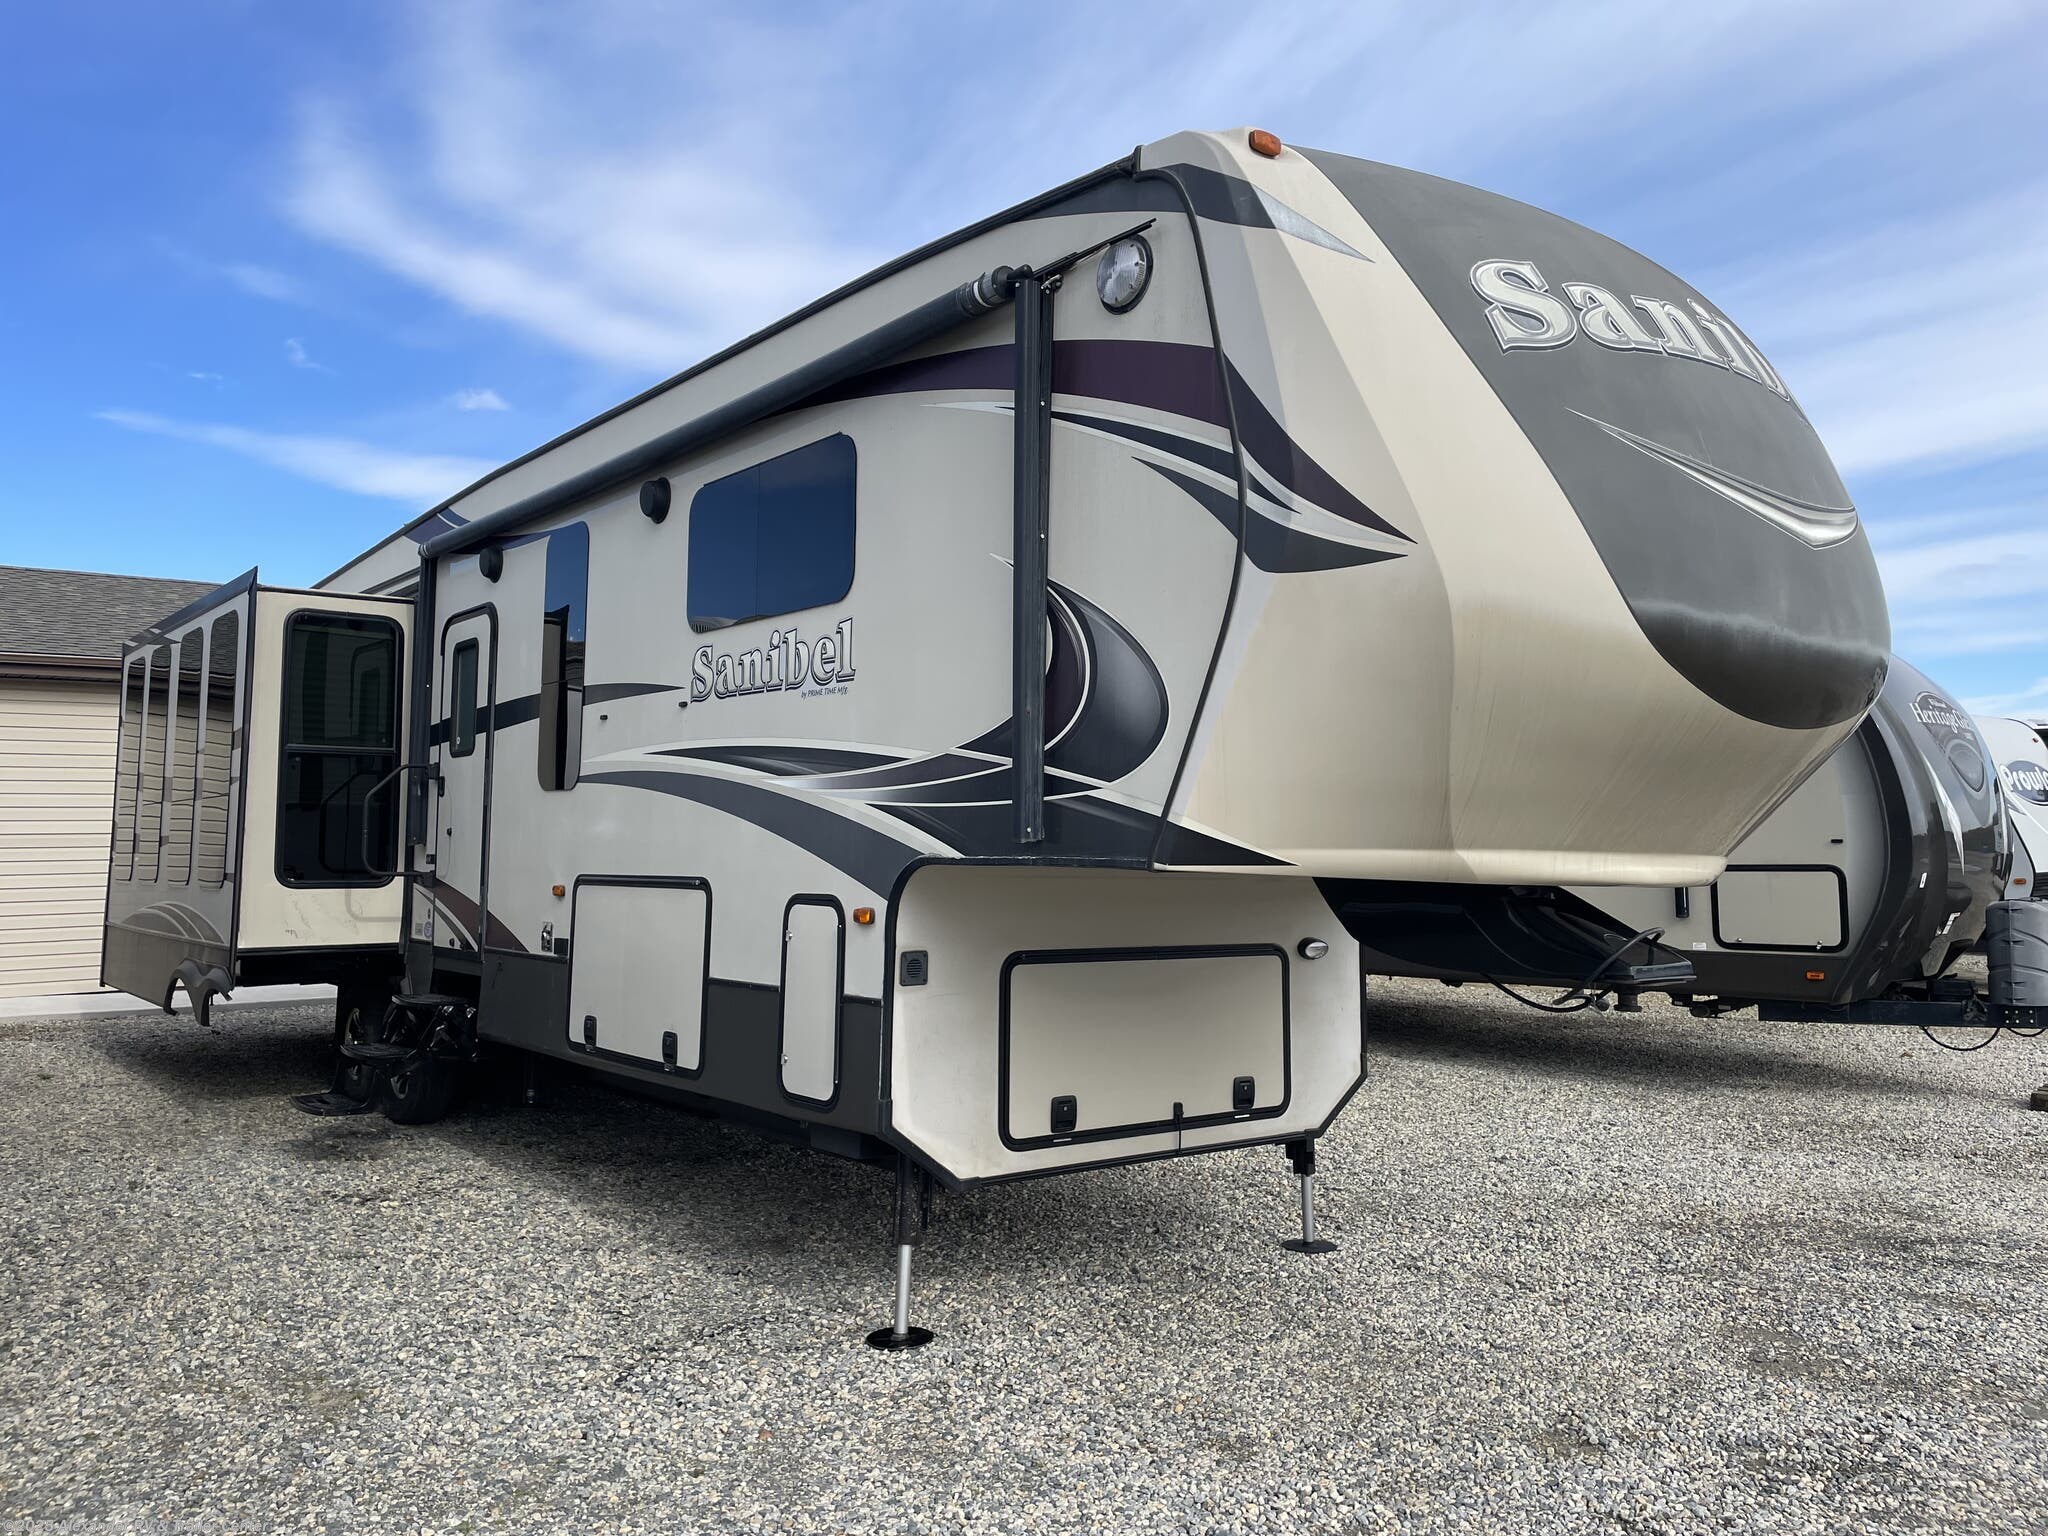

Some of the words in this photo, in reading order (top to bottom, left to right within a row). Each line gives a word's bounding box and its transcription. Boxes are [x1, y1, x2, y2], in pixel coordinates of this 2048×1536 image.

[690, 617, 856, 703] Sanibel
[808, 688, 823, 697] PRIME
[824, 686, 837, 695] TIME
